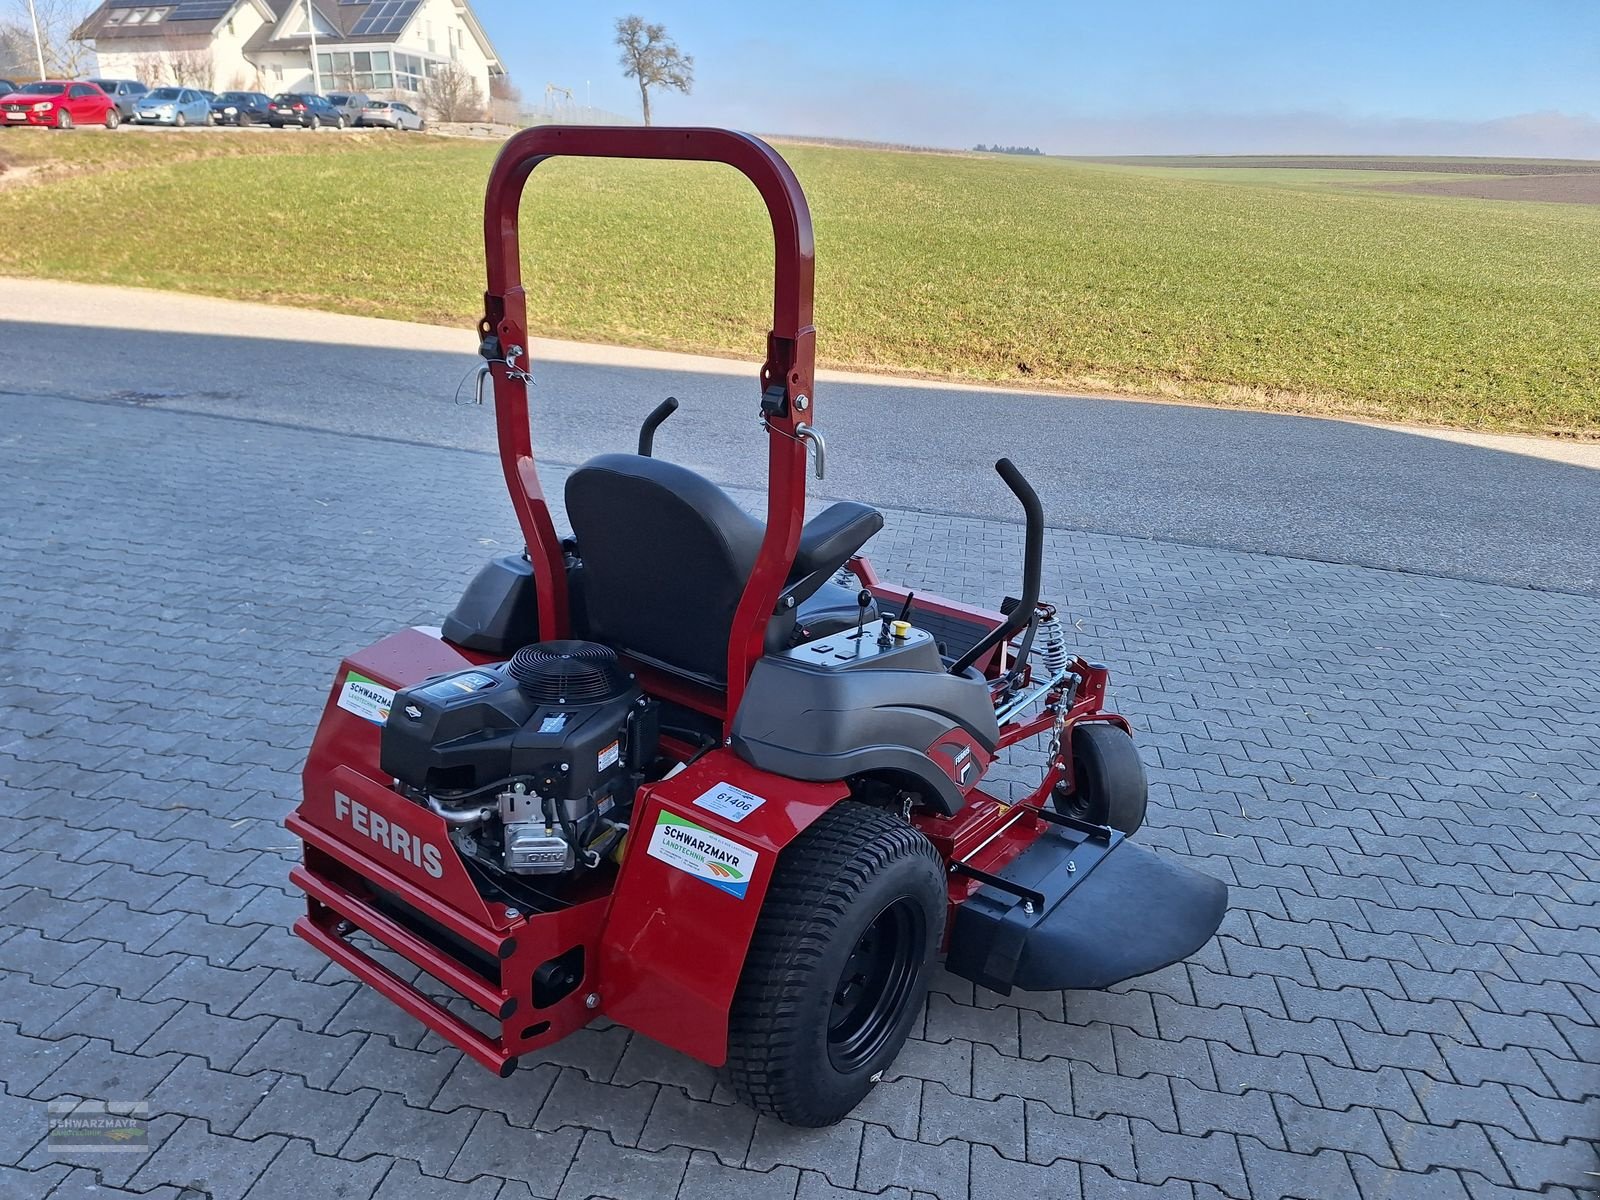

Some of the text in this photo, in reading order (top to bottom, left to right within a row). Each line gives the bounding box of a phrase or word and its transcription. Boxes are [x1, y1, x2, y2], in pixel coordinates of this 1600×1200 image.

[350, 682, 392, 708] SCHWARZMA
[716, 792, 752, 811] 61406
[334, 789, 443, 879] FERRIS
[663, 825, 740, 867] SCHWARZMAYR
[662, 838, 706, 863] LANDTECHNIK
